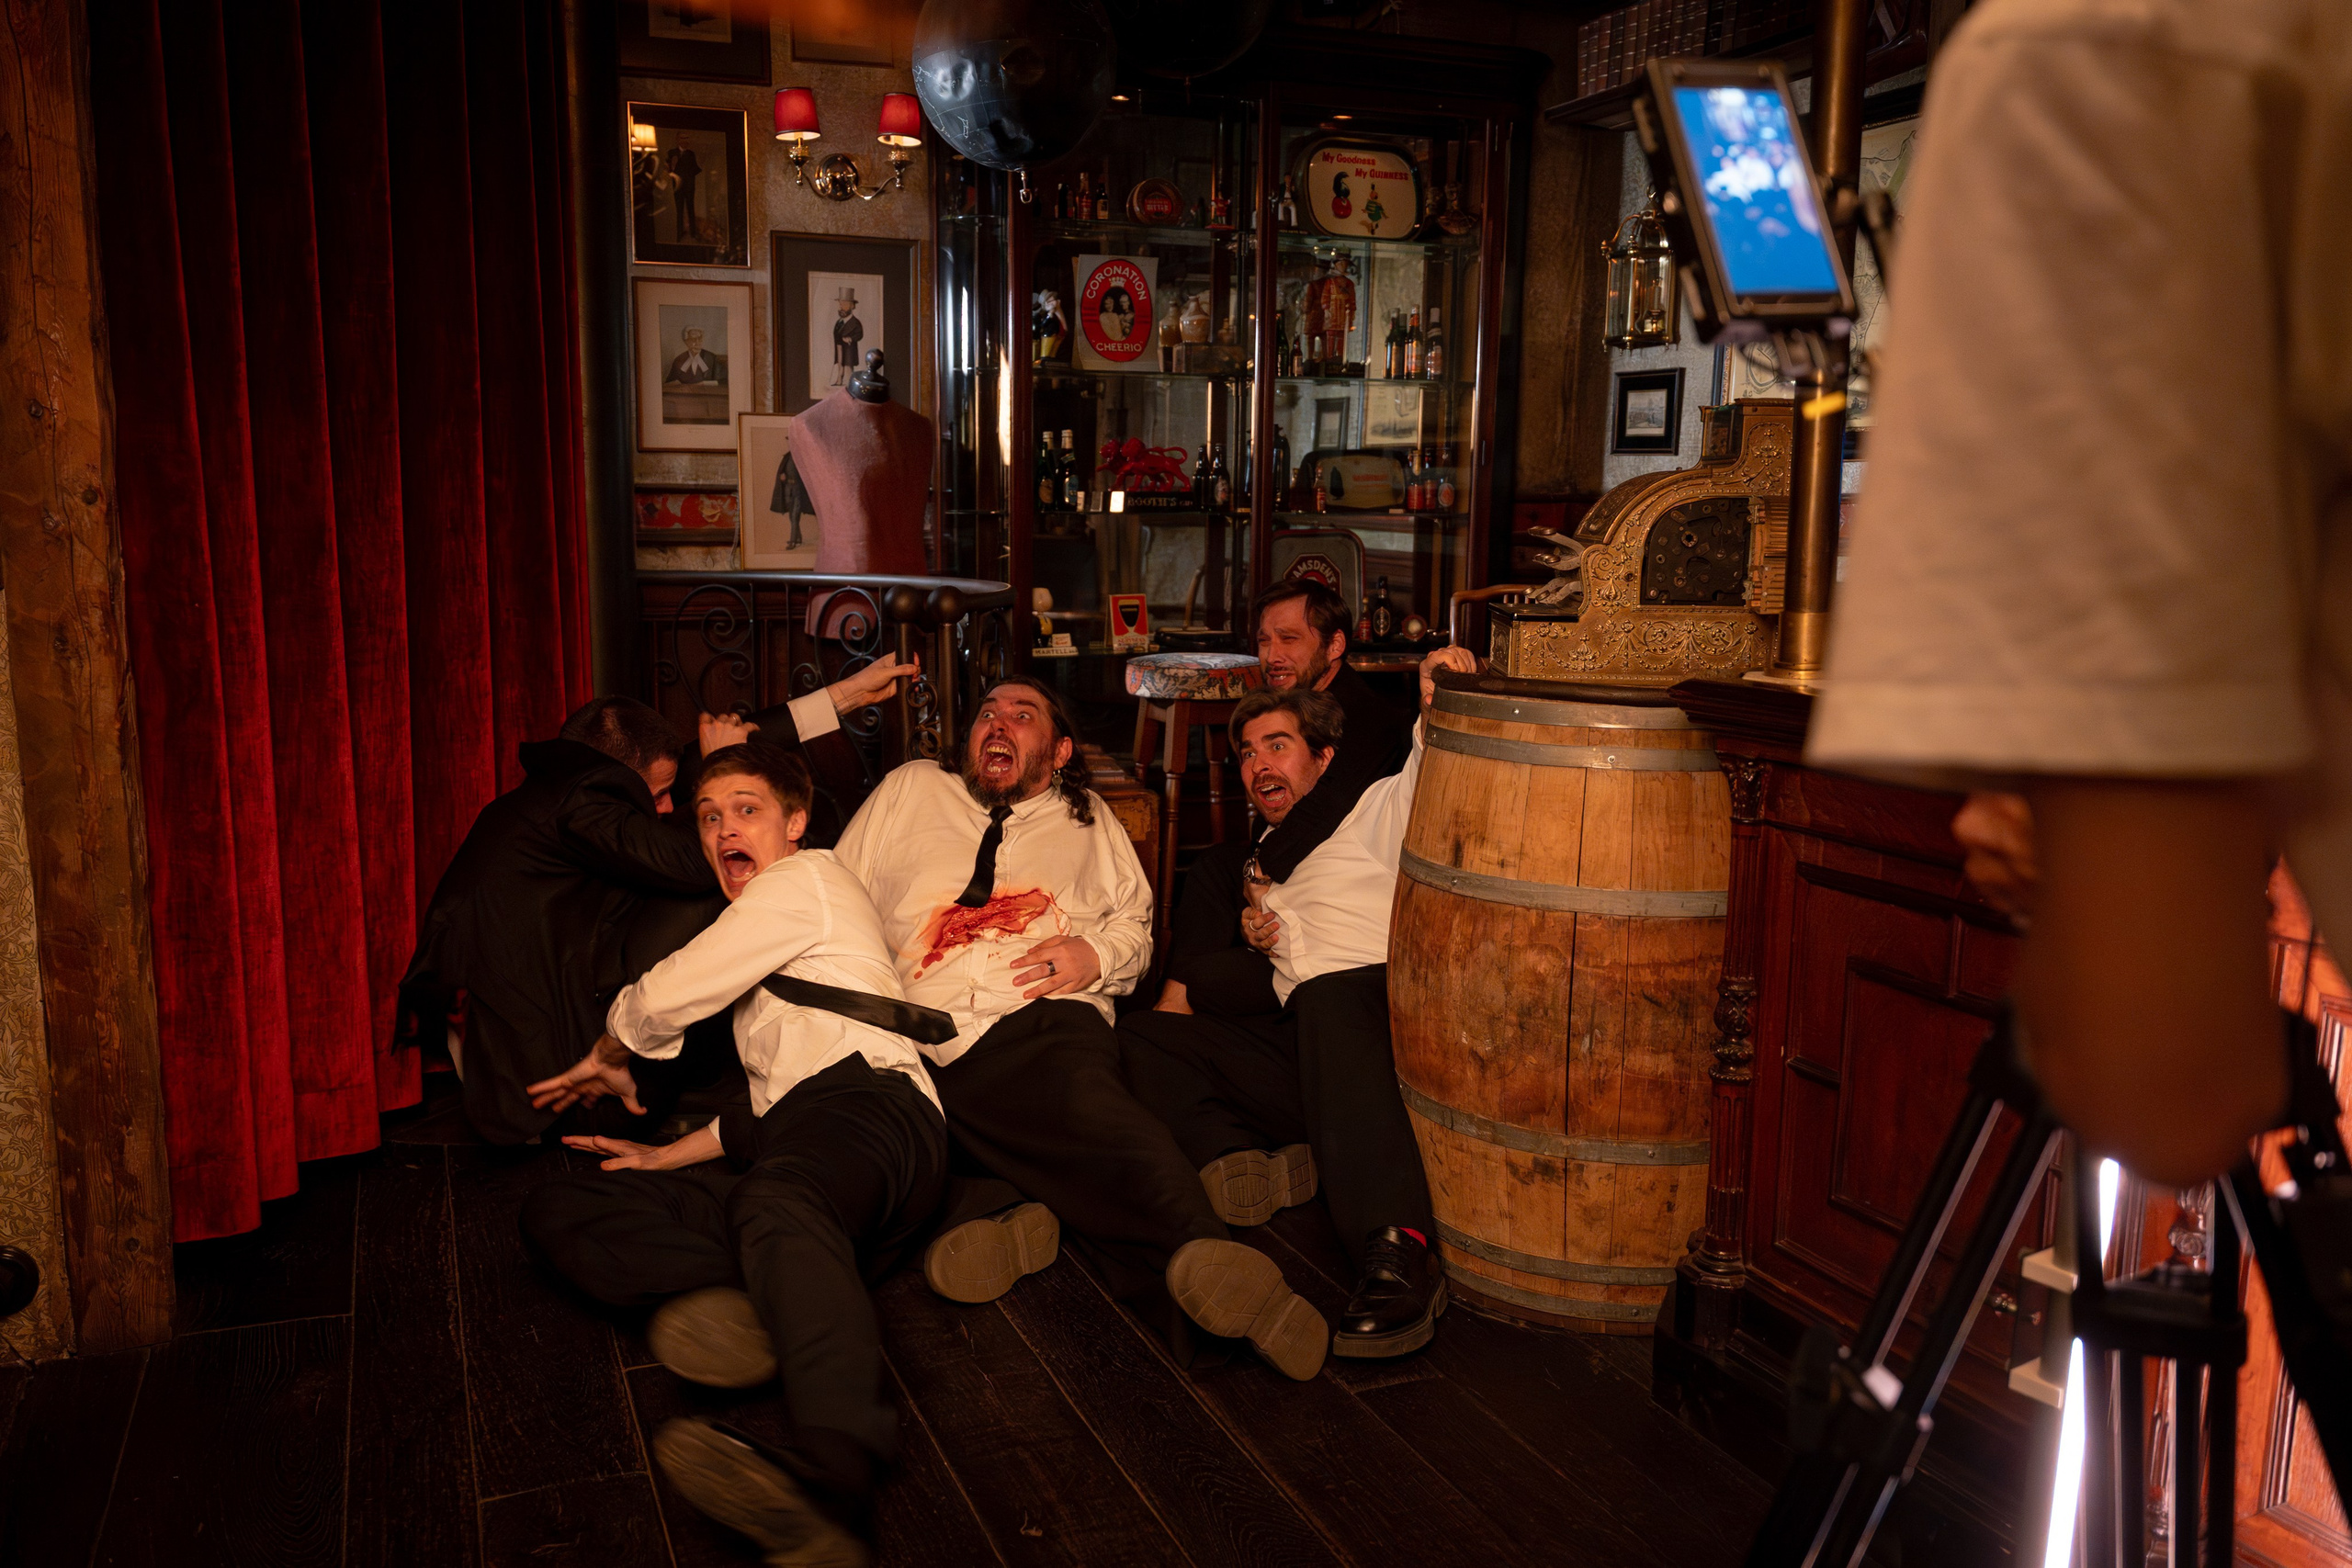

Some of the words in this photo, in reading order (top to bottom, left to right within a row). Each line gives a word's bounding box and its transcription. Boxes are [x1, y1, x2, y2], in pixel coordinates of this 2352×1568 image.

[1321, 152, 1334, 164] My
[1336, 153, 1376, 165] Goodness
[1354, 168, 1367, 179] My
[1086, 265, 1148, 300] CORONATION
[1290, 559, 1337, 584] AMSDEN'S
